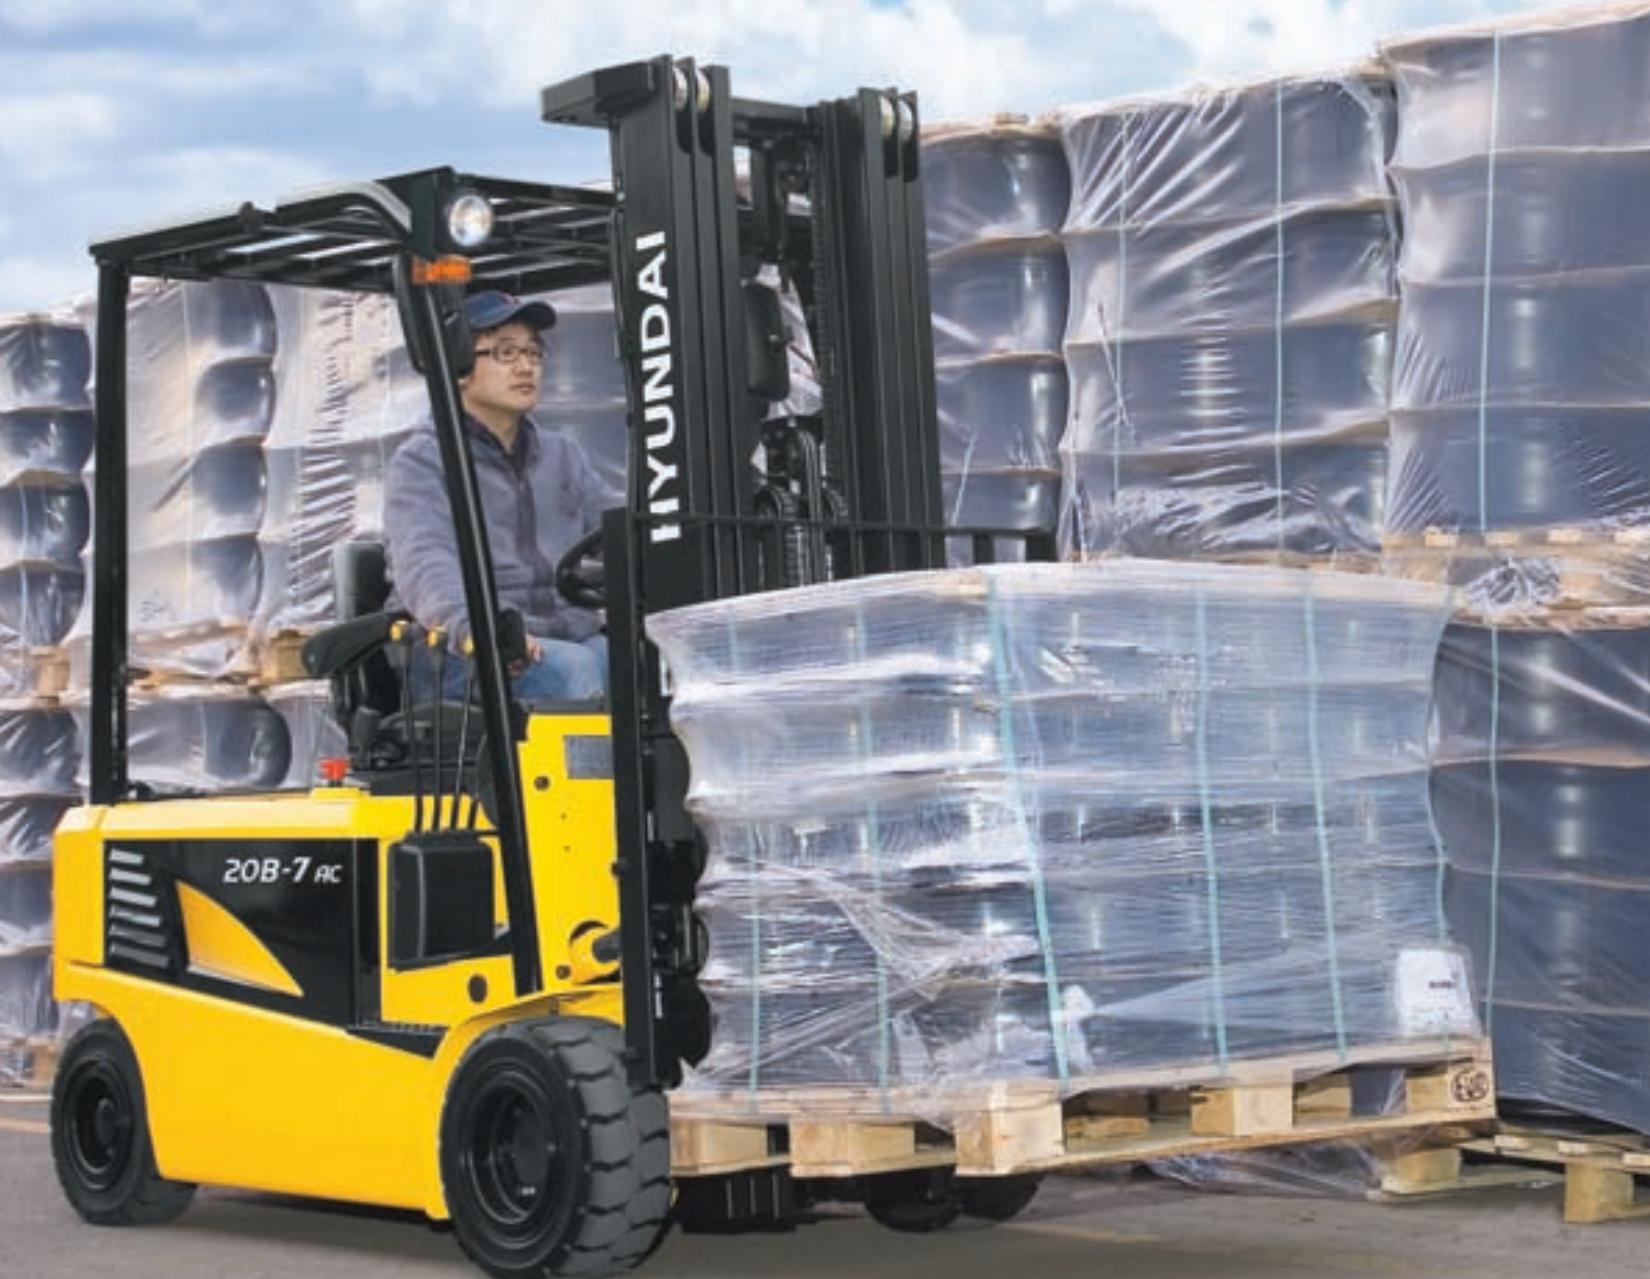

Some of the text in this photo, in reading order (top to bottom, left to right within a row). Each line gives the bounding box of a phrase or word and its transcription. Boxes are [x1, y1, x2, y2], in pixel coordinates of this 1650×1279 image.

[634, 230, 682, 544] HYUNDAI
[223, 856, 343, 883] 20B-7 AC
